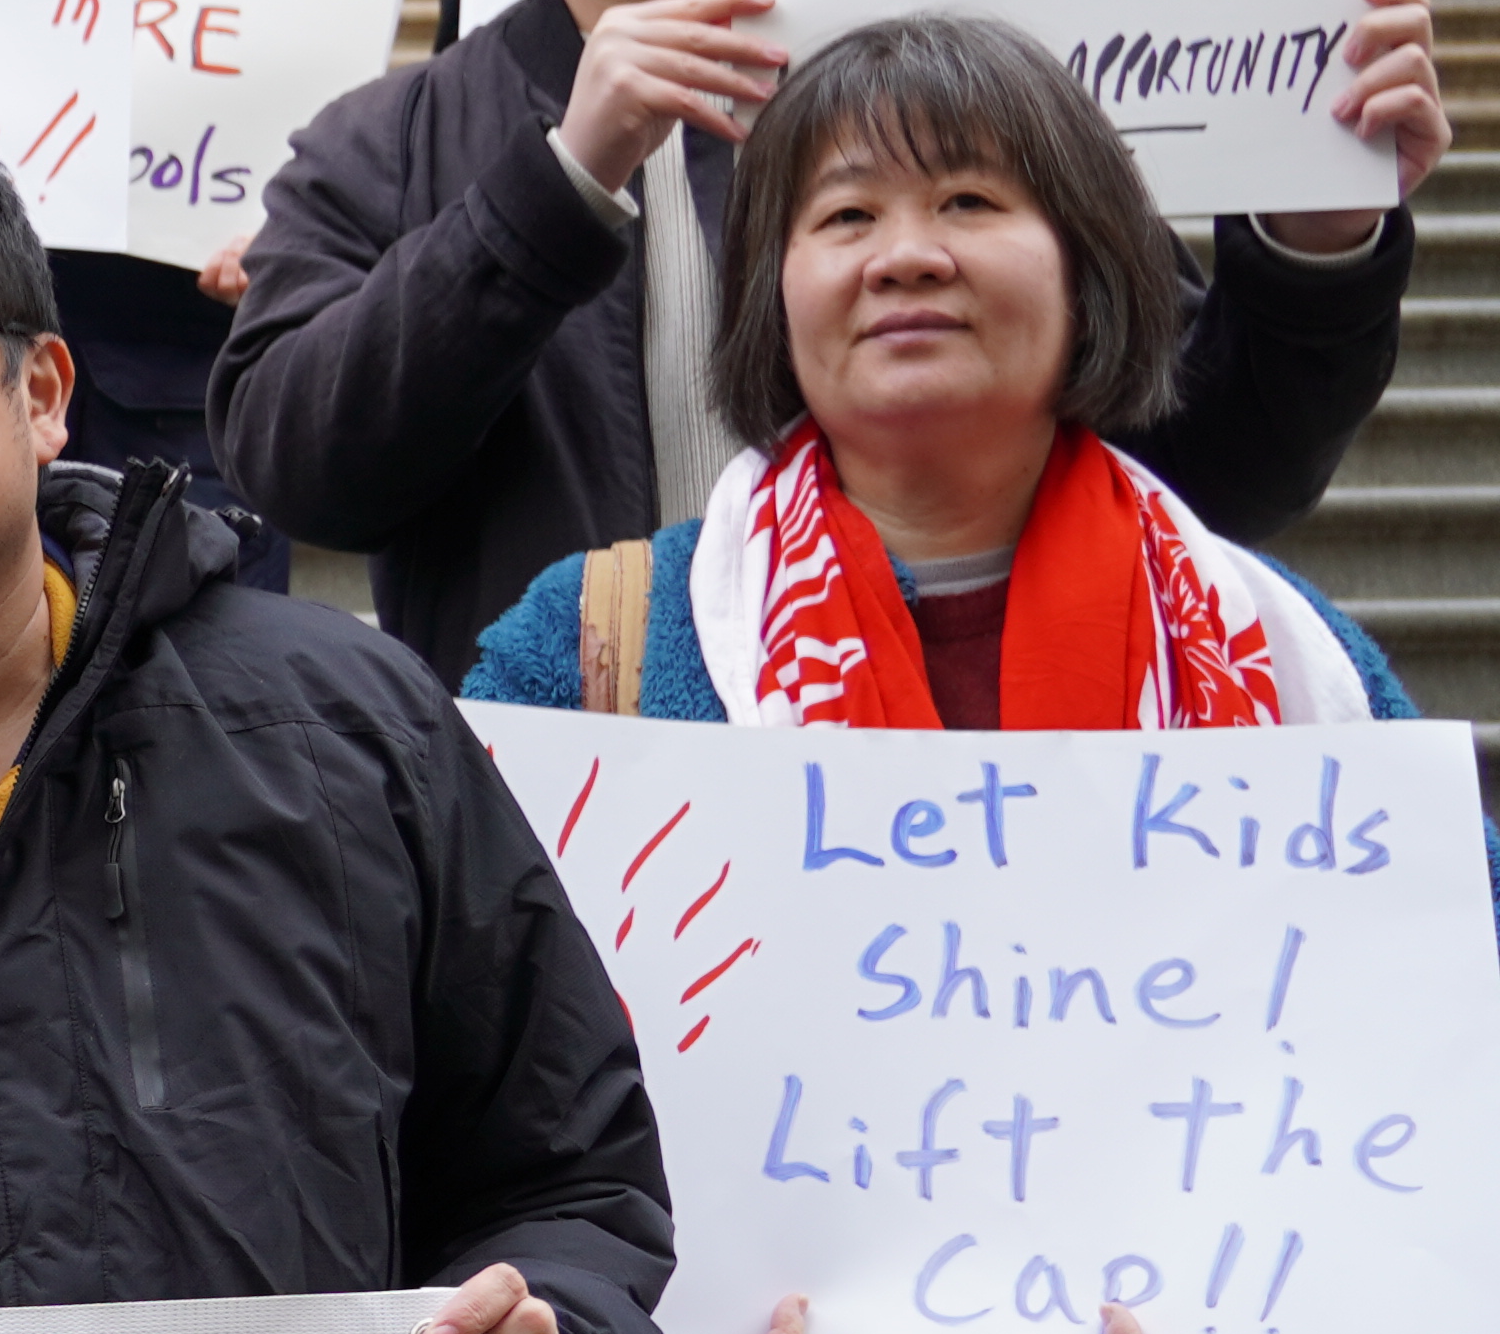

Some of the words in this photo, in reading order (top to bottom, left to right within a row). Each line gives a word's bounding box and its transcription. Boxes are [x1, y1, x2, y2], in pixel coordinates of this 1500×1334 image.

[802, 759, 1038, 873] Let
[1131, 750, 1393, 876] Kids
[762, 1074, 1060, 1203] Lift
[1149, 1075, 1425, 1193] the
